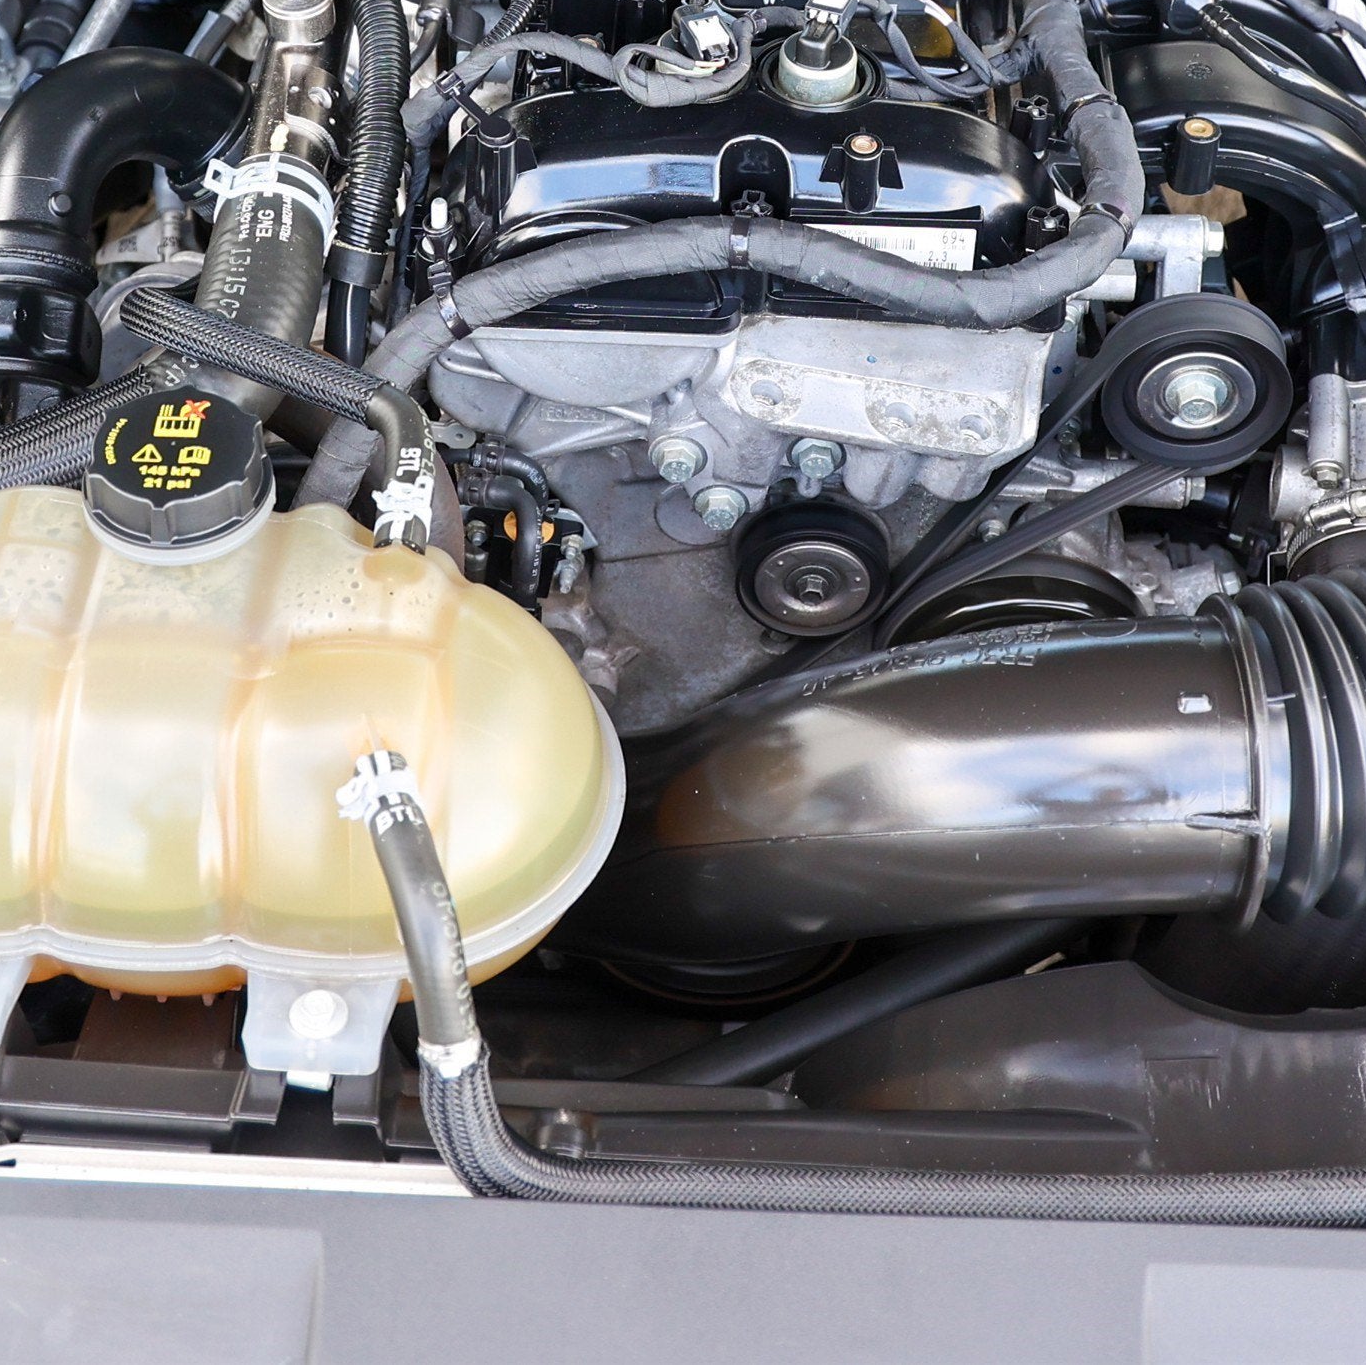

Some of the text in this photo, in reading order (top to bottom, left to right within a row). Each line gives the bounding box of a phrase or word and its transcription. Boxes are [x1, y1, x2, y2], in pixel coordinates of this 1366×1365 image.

[942, 230, 966, 245] 694
[927, 250, 948, 263] 2.3
[138, 465, 202, 477] 145 kPa
[143, 477, 192, 491] 21 psi
